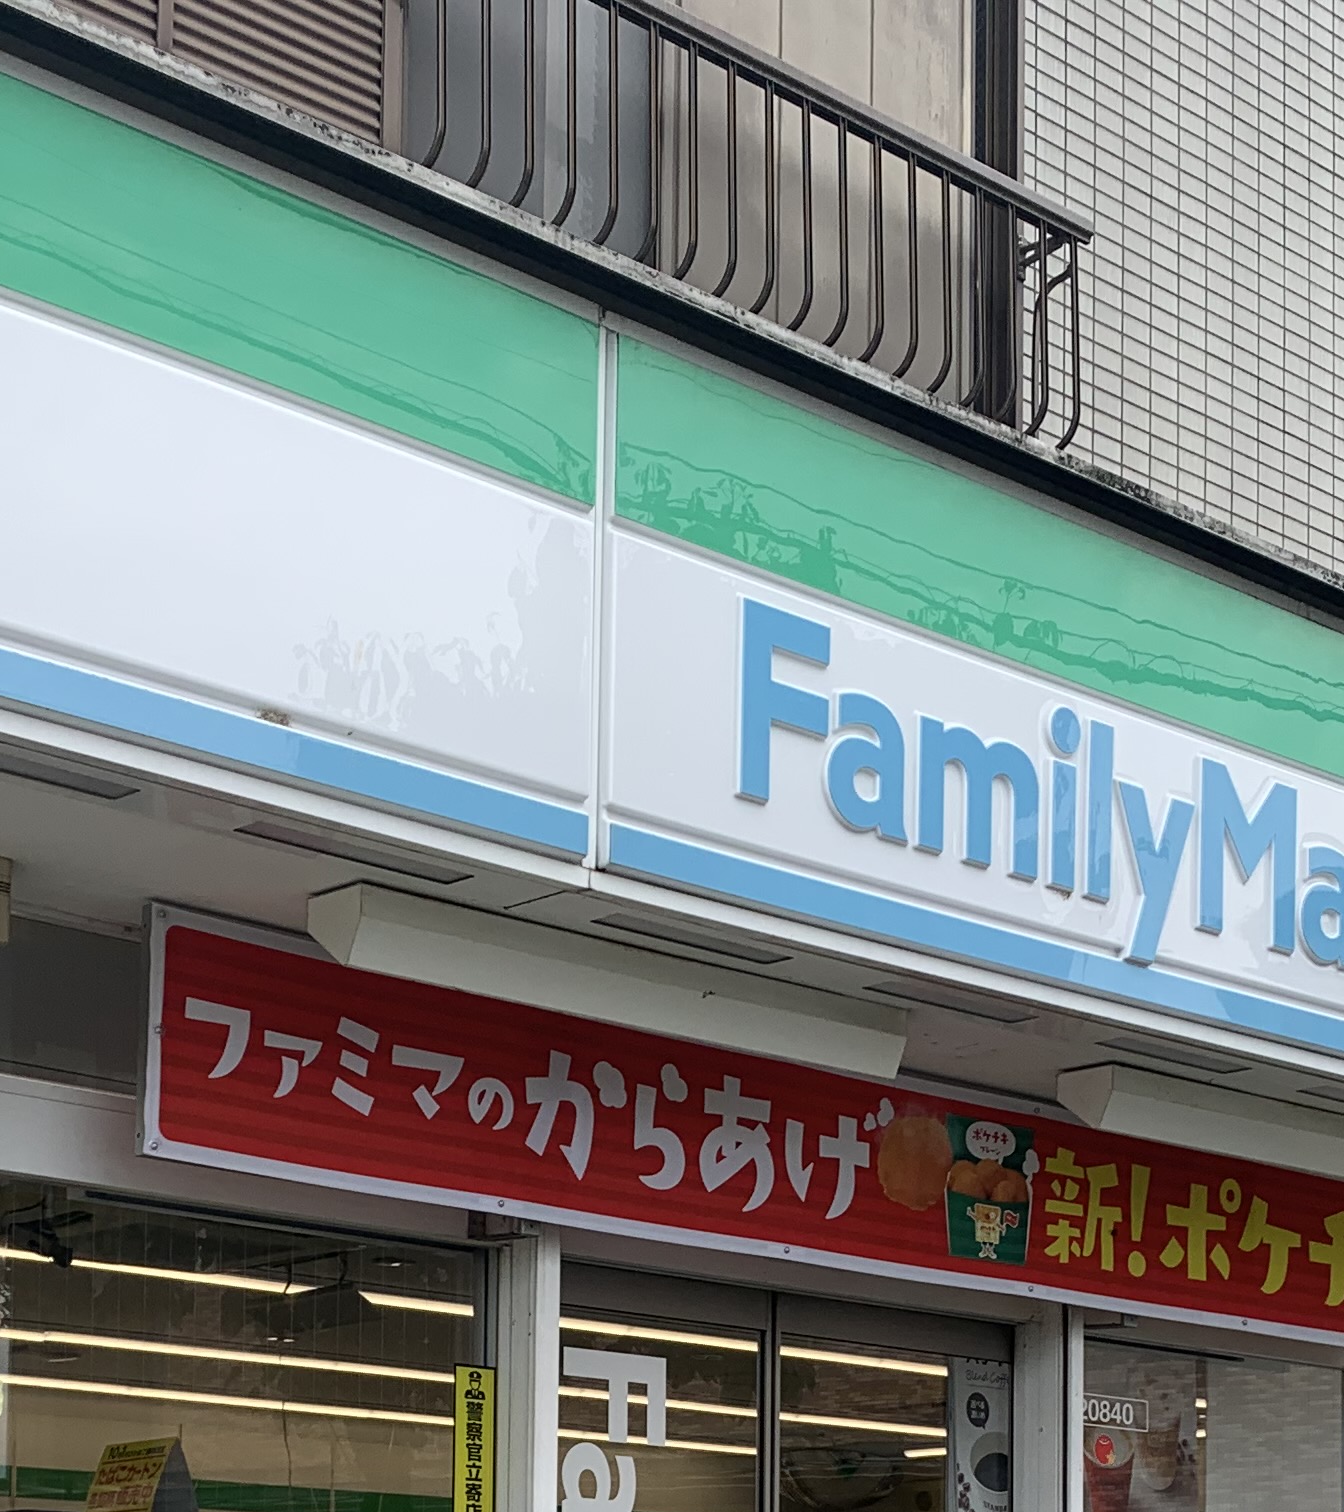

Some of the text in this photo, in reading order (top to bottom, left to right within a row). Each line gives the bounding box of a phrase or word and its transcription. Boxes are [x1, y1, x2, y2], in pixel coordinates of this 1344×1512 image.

[184, 996, 895, 1220] ファミマのからあげ
[972, 1128, 1008, 1144] ポケチキ
